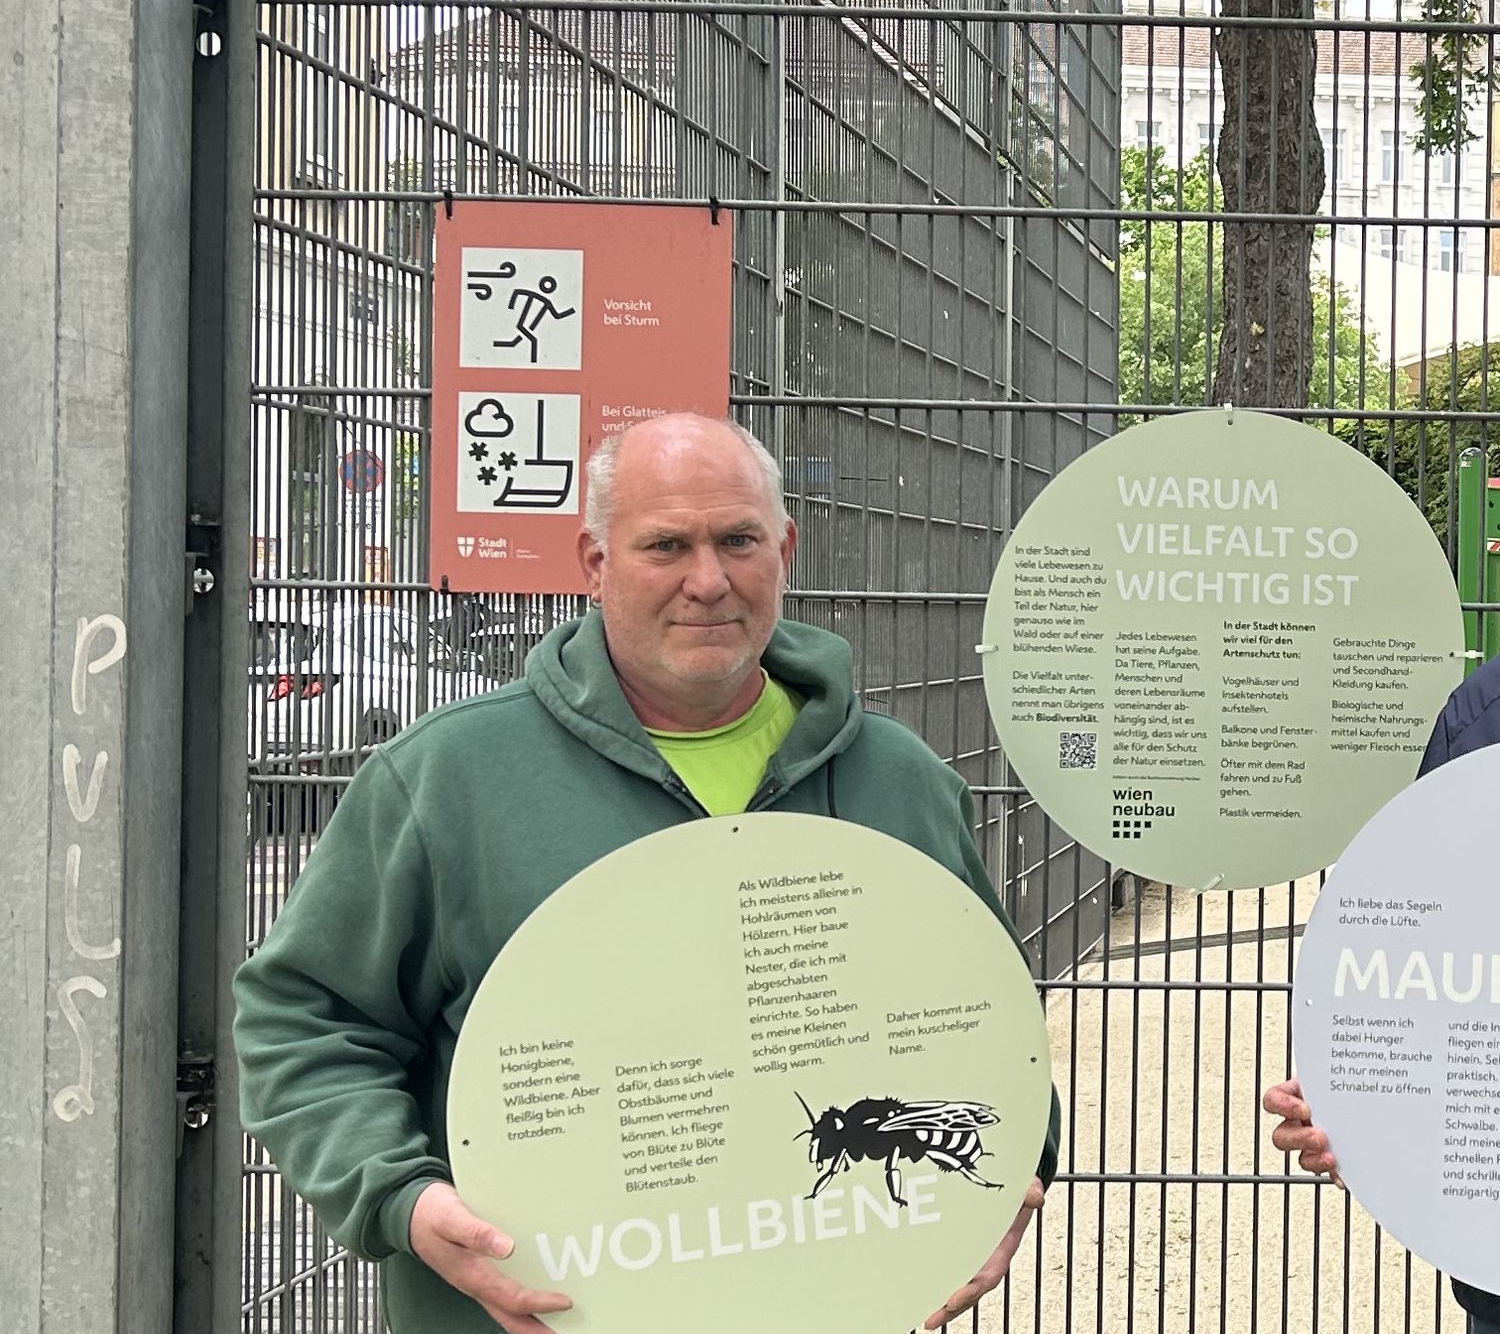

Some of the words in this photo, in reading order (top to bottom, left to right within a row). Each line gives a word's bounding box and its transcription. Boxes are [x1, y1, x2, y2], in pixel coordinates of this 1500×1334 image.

[604, 298, 652, 312] Vorsicht
[603, 313, 622, 326] bei
[624, 313, 660, 327] Sturm
[602, 405, 621, 417] Bei
[1117, 474, 1279, 511] WARUM
[479, 537, 507, 548] Stadt
[1116, 522, 1296, 559] VIELFALT
[1304, 526, 1360, 560] SO
[479, 548, 507, 559] Wien
[1114, 569, 1291, 606] WICHTIG
[1302, 572, 1360, 607] IST
[1223, 619, 1233, 629] In
[1234, 620, 1251, 630] der
[1252, 620, 1278, 631] Stadt
[1280, 621, 1316, 632] können
[1222, 634, 1238, 643] wir
[1240, 634, 1257, 644] viel
[1258, 634, 1273, 644] für
[1274, 635, 1293, 645] den
[1222, 648, 1280, 658] Artenschutz
[1112, 786, 1153, 801] wien
[1112, 803, 1176, 817] neubau
[1339, 897, 1355, 908] Ich
[1357, 897, 1383, 909] liebe
[1385, 898, 1404, 910] das
[1406, 899, 1442, 914] Segeln
[1338, 913, 1369, 925] durch
[1371, 914, 1388, 925] die
[1390, 915, 1420, 927] Lüfte.
[1332, 1014, 1364, 1026] Selbst
[1366, 1018, 1396, 1027] wenn
[1398, 1017, 1414, 1028] ich
[1331, 1031, 1361, 1042] dabei
[1364, 1032, 1404, 1047] Hunger
[499, 1044, 517, 1056] Ich
[519, 1043, 539, 1054] bin
[541, 1039, 574, 1051] keine
[1331, 1047, 1386, 1061] bekomme,
[1389, 1049, 1432, 1062] brauche
[500, 1057, 574, 1073] Honigbiene,
[615, 1065, 648, 1076] Denn
[649, 1059, 667, 1071] ich
[669, 1057, 702, 1070] sorge
[1330, 1063, 1346, 1074] ich
[1348, 1067, 1366, 1075] nur
[1368, 1066, 1408, 1077] meinen
[502, 1076, 552, 1091] sondern
[554, 1072, 580, 1083] eine
[616, 1079, 651, 1093] dafür,
[653, 1077, 680, 1088] dass
[682, 1071, 706, 1084] sich
[707, 1068, 734, 1080] viele
[1329, 1079, 1378, 1092] Schnabel
[1380, 1085, 1393, 1093] zu
[1395, 1082, 1431, 1095] öffnen
[503, 1092, 568, 1107] Wildbiene.
[571, 1086, 600, 1098] Aber
[618, 1093, 687, 1109] Obstbäume
[690, 1086, 713, 1100] und
[505, 1110, 543, 1124] fleißig
[545, 1108, 565, 1118] bin
[567, 1103, 585, 1115] ich
[619, 1113, 664, 1127] Blumen
[666, 1104, 729, 1119] vermehren
[507, 1125, 565, 1141] trotzdem.
[620, 1129, 667, 1142] können.
[671, 1124, 688, 1135] Ich
[690, 1121, 723, 1133] fliege
[622, 1149, 645, 1159] von
[647, 1144, 677, 1156] Blüte
[680, 1142, 693, 1151] zu
[695, 1137, 726, 1149] Blüte
[624, 1163, 647, 1176] und
[649, 1157, 693, 1172] verteile
[695, 1154, 718, 1165] den
[625, 1173, 698, 1193] Blütenstaub.
[537, 1173, 942, 1282] WOLLBIENE
